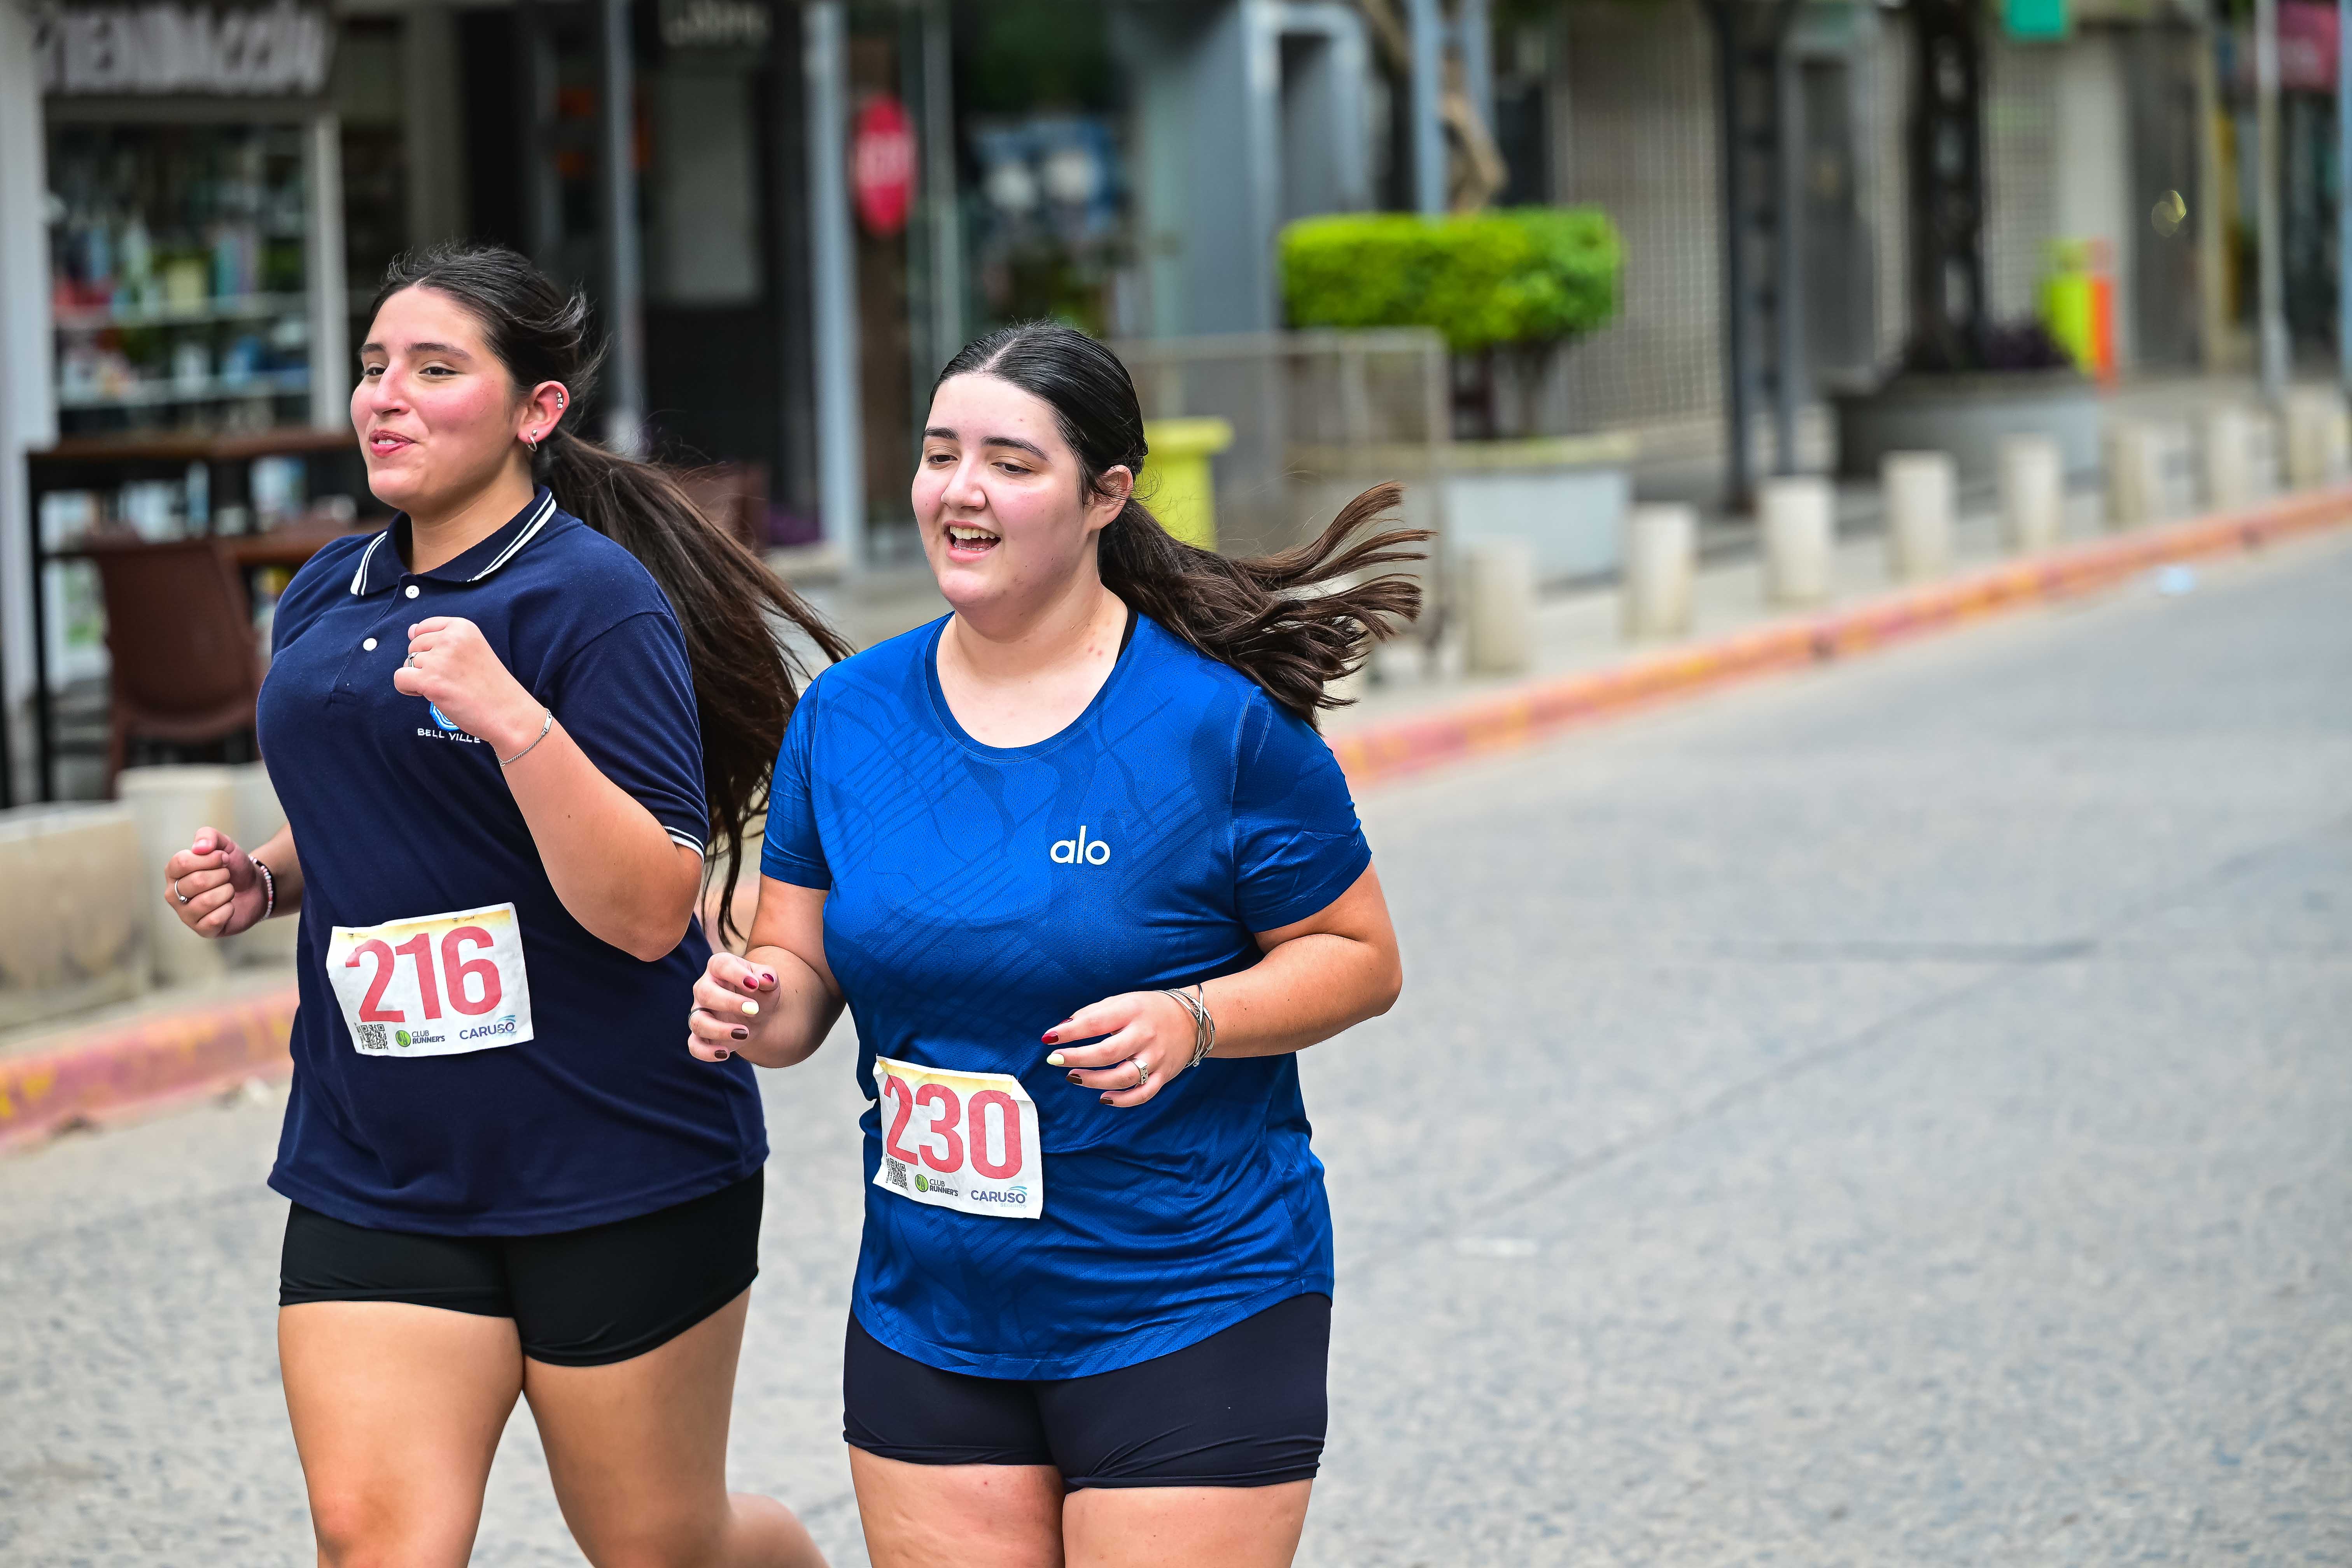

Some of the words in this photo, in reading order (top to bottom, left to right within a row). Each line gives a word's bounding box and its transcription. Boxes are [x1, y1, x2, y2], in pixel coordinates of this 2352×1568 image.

[417, 728, 445, 738] BELL
[448, 732, 480, 743] VILLE
[1050, 825, 1110, 865] alo
[345, 926, 502, 1022] 216
[459, 1021, 515, 1040] CARUSO
[884, 1075, 1022, 1179] 230
[929, 1185, 958, 1197] RUNNER'S
[971, 1190, 1026, 1203] CARUSO
